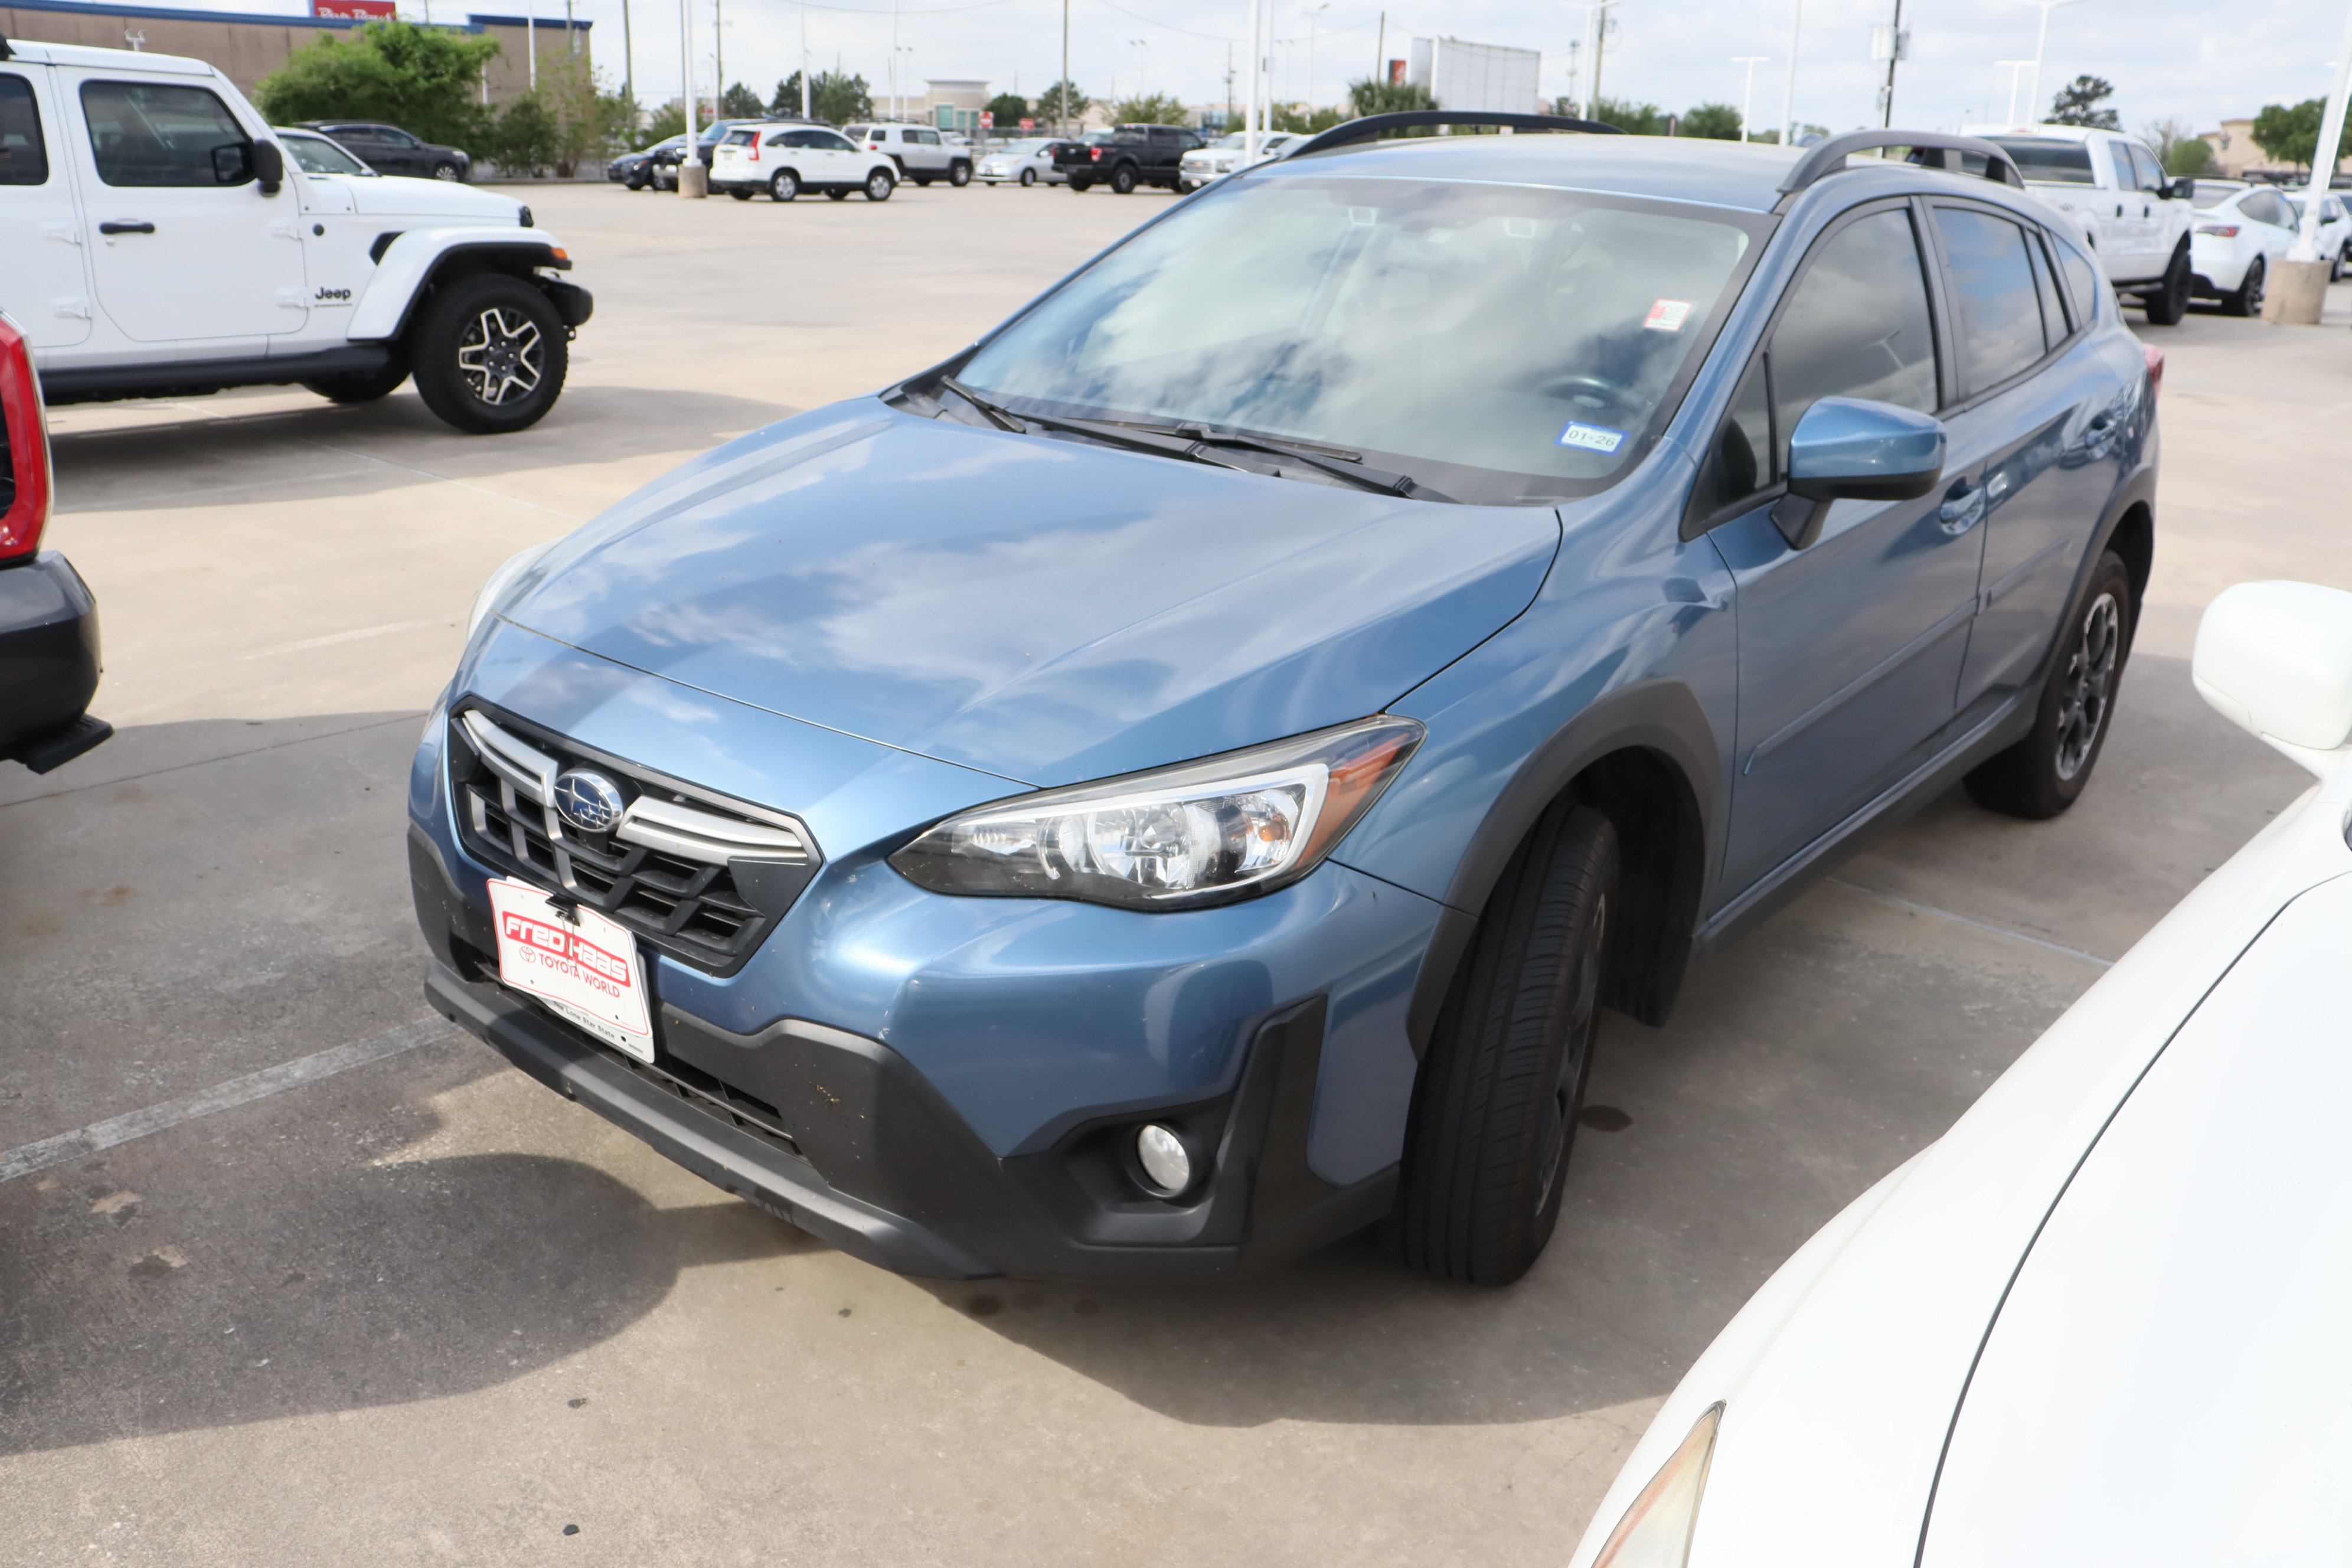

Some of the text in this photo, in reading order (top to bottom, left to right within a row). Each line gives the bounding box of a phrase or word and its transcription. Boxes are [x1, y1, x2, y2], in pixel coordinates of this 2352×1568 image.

[314, 286, 351, 301] Jeep
[538, 952, 620, 998] TOYOTA WORLD
[566, 1007, 581, 1020] Lone
[583, 1017, 596, 1028] Star
[598, 1025, 615, 1039] State
